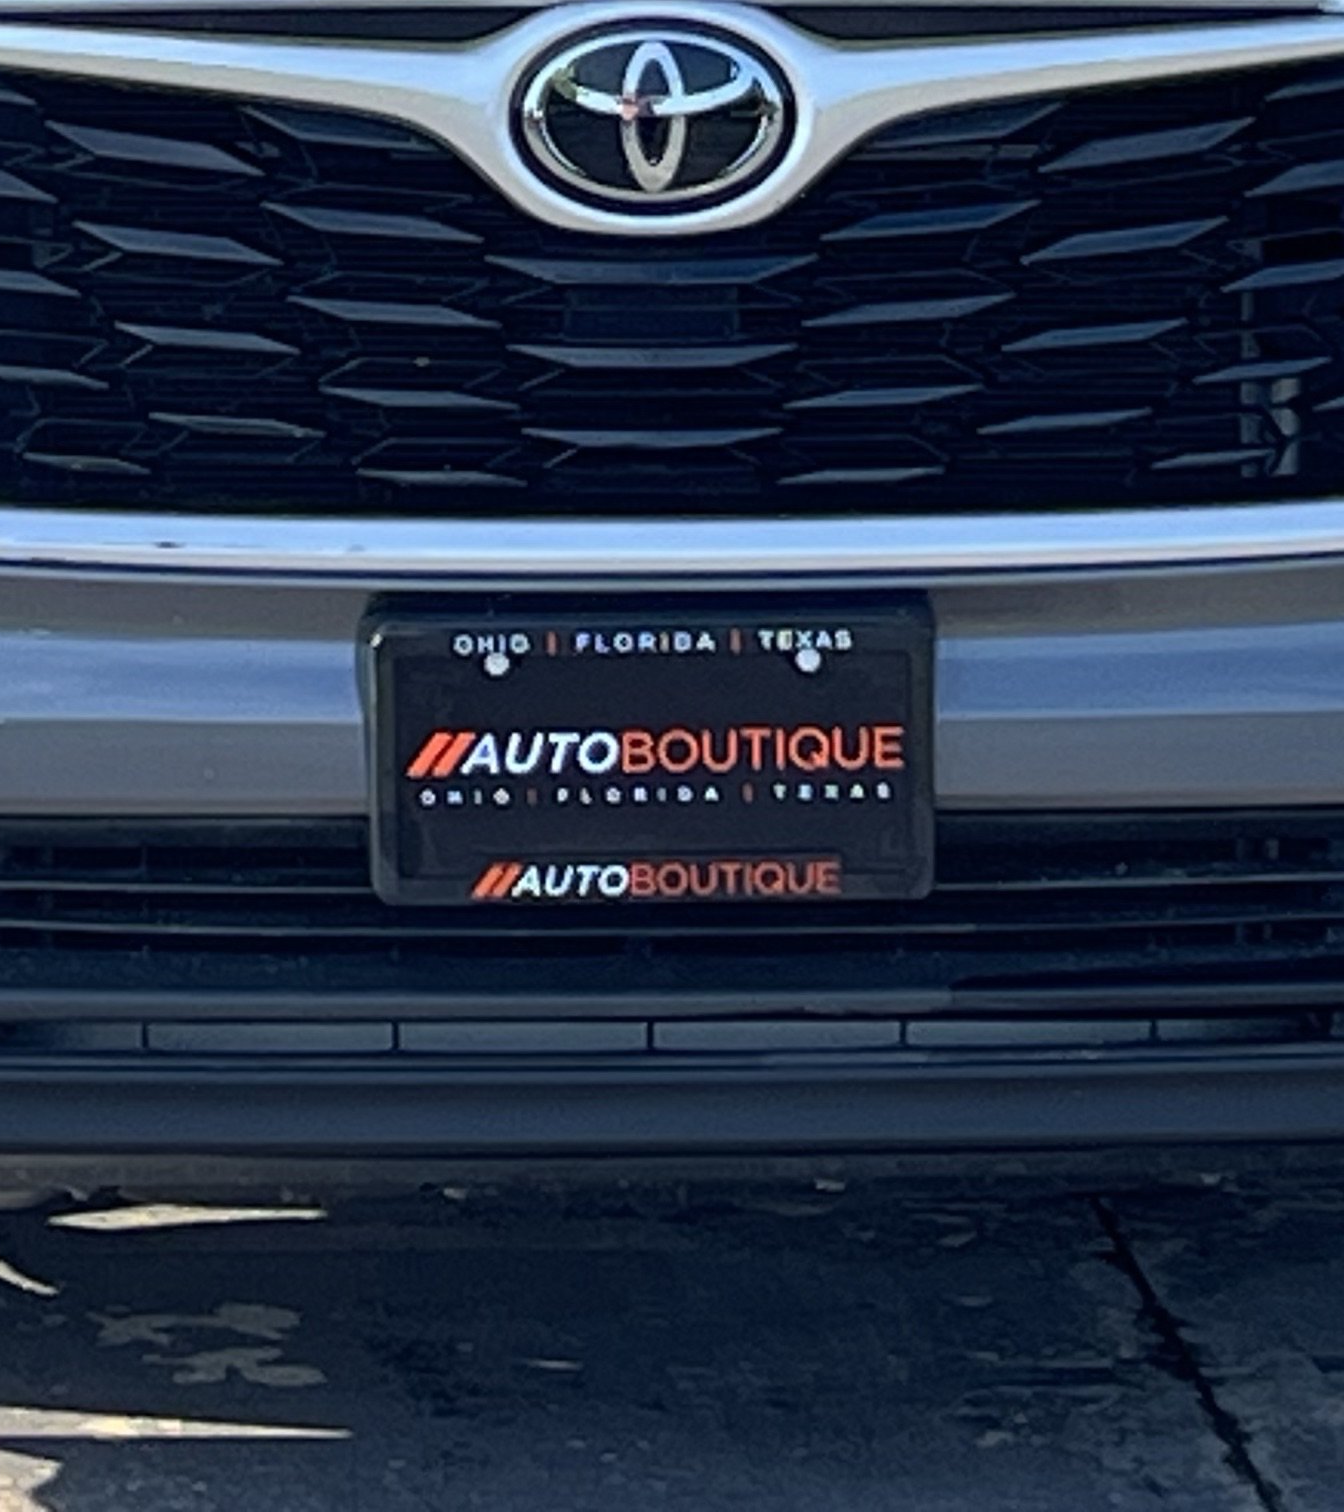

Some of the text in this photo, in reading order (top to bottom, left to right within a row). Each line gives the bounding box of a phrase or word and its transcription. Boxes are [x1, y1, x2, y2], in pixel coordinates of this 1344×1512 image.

[453, 628, 853, 656] OHIO FLORIDA TEXAS
